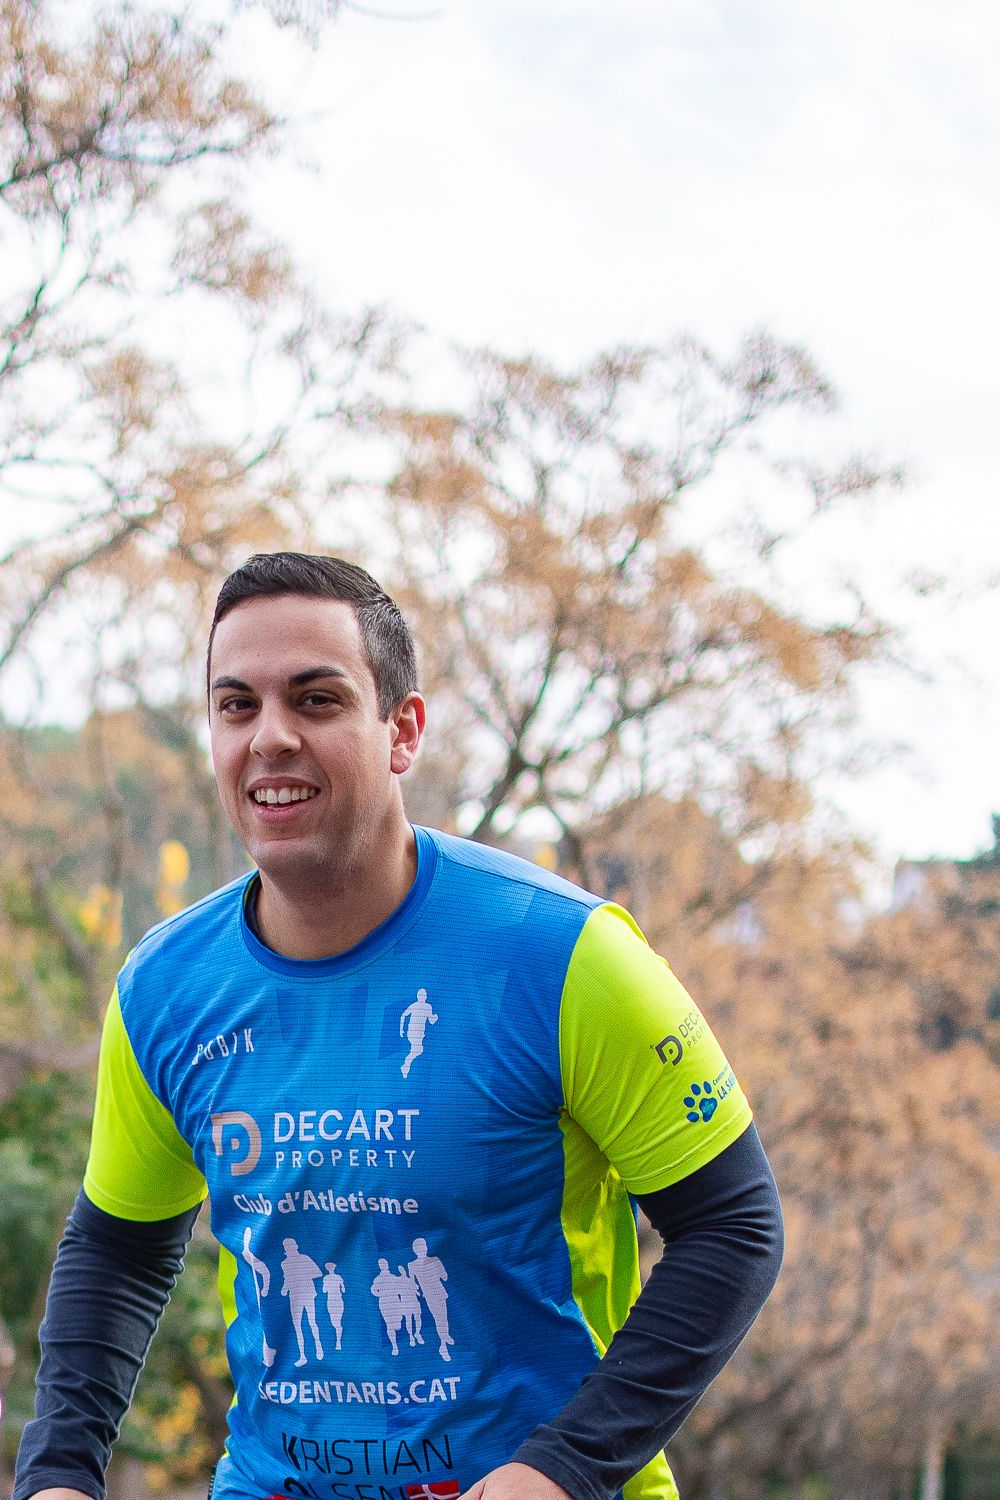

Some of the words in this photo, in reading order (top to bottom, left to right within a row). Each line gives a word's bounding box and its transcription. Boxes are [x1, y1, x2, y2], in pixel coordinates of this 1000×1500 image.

[273, 1109, 420, 1143] DECART
[275, 1149, 416, 1169] PROPERTY
[233, 1192, 272, 1216] Club
[278, 1189, 419, 1215] d'Atletisme
[281, 1432, 453, 1476] KRISTIAN
